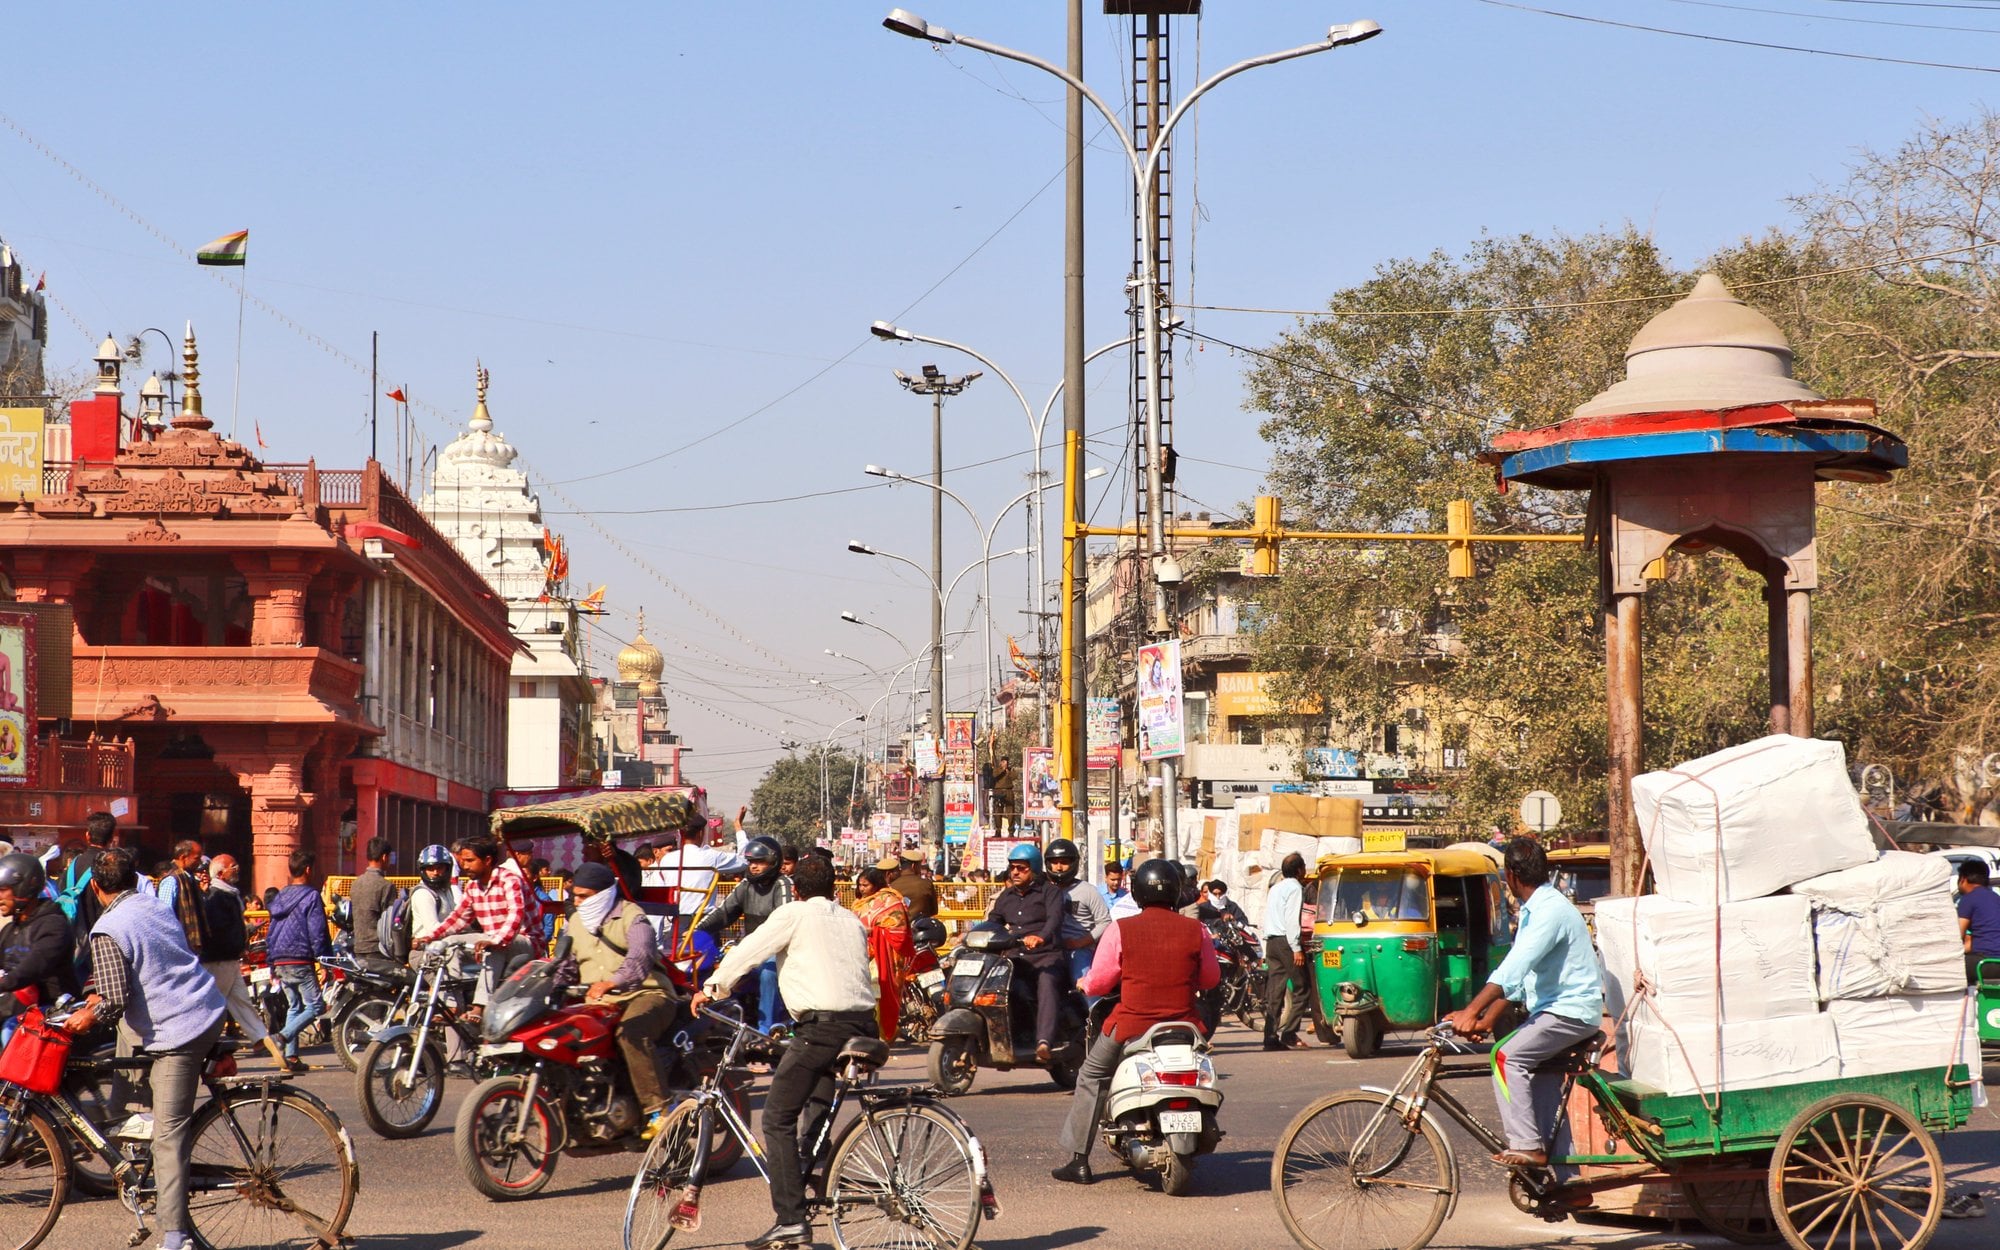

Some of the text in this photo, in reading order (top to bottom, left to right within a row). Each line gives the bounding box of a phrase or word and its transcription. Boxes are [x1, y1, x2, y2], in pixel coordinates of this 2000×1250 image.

[1221, 676, 1254, 692] RANA
[1230, 784, 1259, 793] YAMAHA
[1088, 799, 1111, 807] Niko
[1171, 1114, 1194, 1122] DL2S
